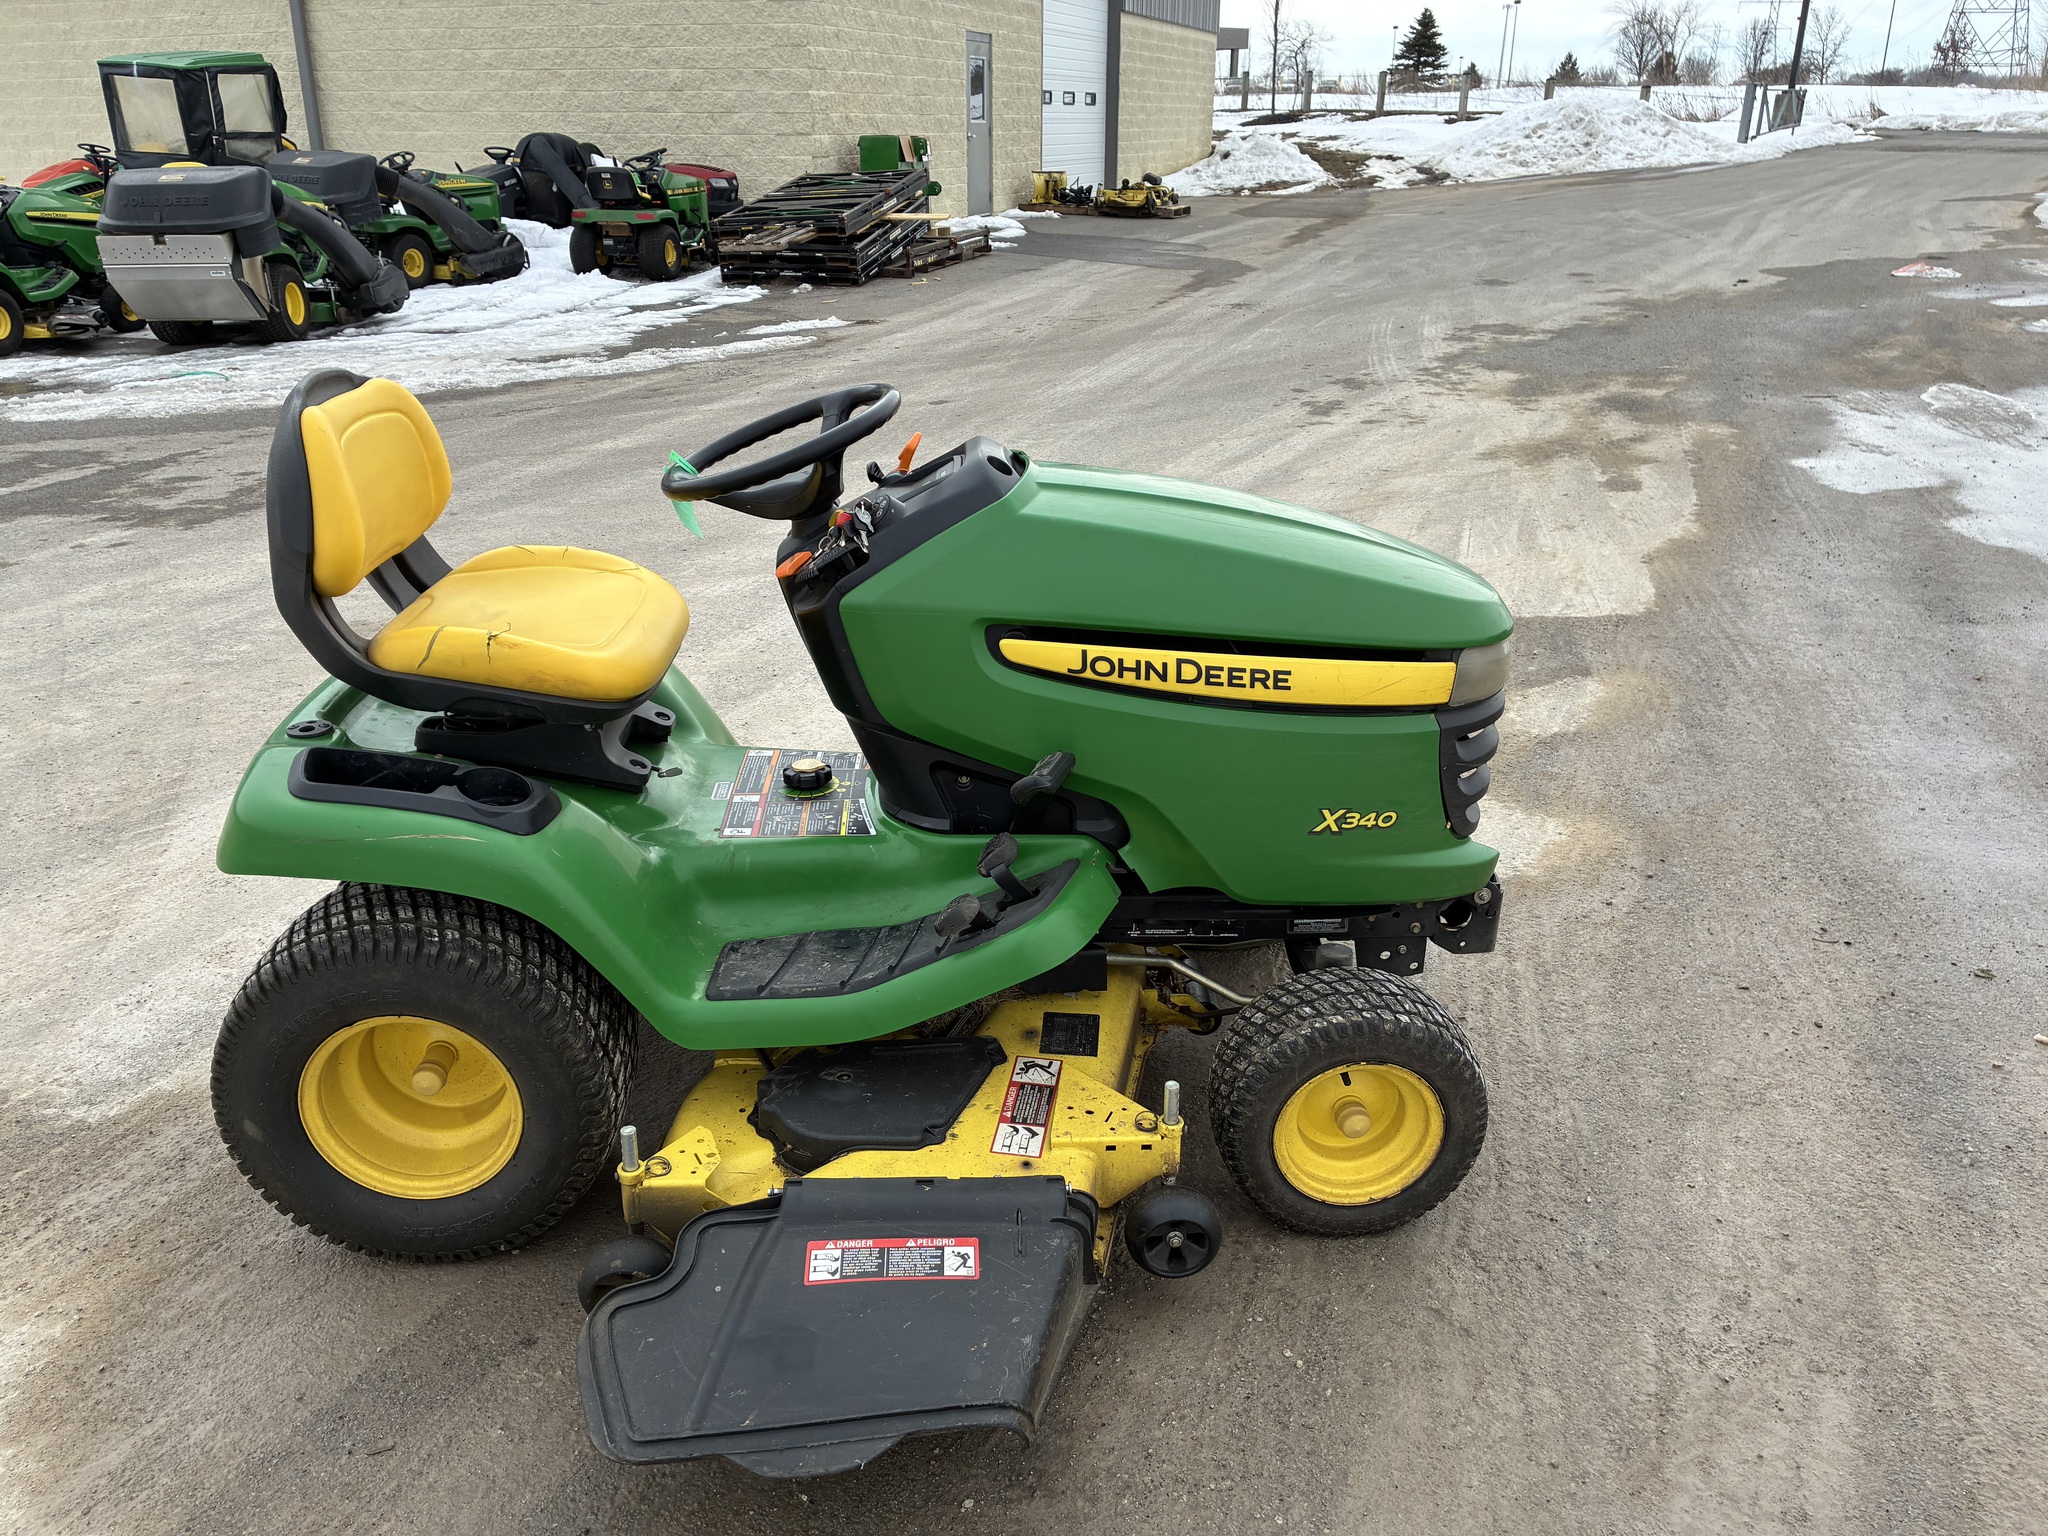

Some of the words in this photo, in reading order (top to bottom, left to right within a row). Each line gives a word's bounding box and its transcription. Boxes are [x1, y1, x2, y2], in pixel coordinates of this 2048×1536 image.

[291, 175, 321, 184] DEERE
[121, 196, 159, 207] JOHN
[162, 195, 210, 207] DEERE
[1067, 649, 1168, 683] JOHN
[1175, 657, 1292, 691] DEERE
[1308, 807, 1399, 835] X340
[267, 989, 402, 1058] CARLISLE
[1004, 1086, 1018, 1110] DANGER
[837, 1239, 873, 1248] DANGER
[917, 1238, 956, 1246] PELIGRO
